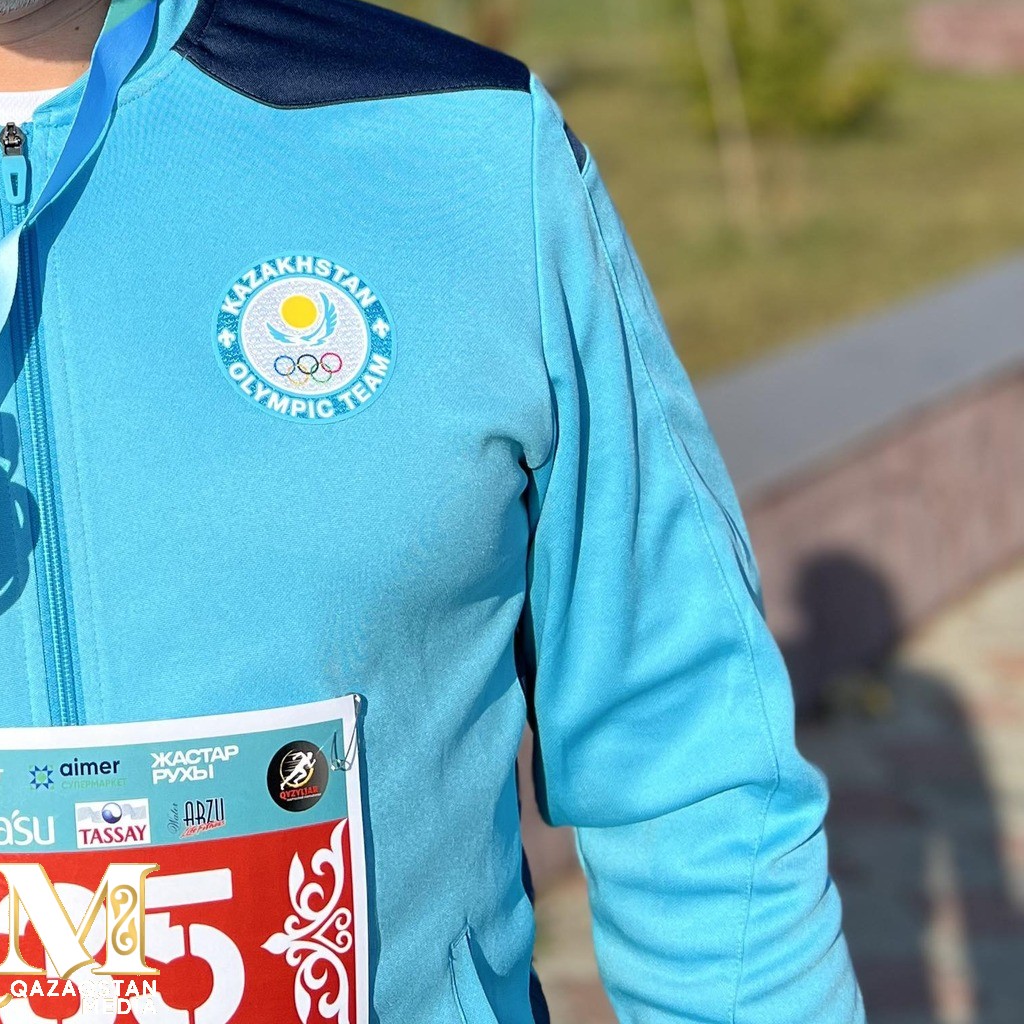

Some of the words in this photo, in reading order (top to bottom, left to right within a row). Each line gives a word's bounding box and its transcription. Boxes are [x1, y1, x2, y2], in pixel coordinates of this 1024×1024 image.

[221, 256, 377, 316] KAZAKHSTAN
[229, 361, 334, 419] OLYMPIC
[338, 354, 391, 411] TEAM
[60, 758, 120, 777] aimer
[150, 745, 239, 768] ЖАСТАР
[152, 764, 214, 784] РУХЫ
[183, 798, 224, 826] ARZU
[78, 824, 147, 845] TASSAY
